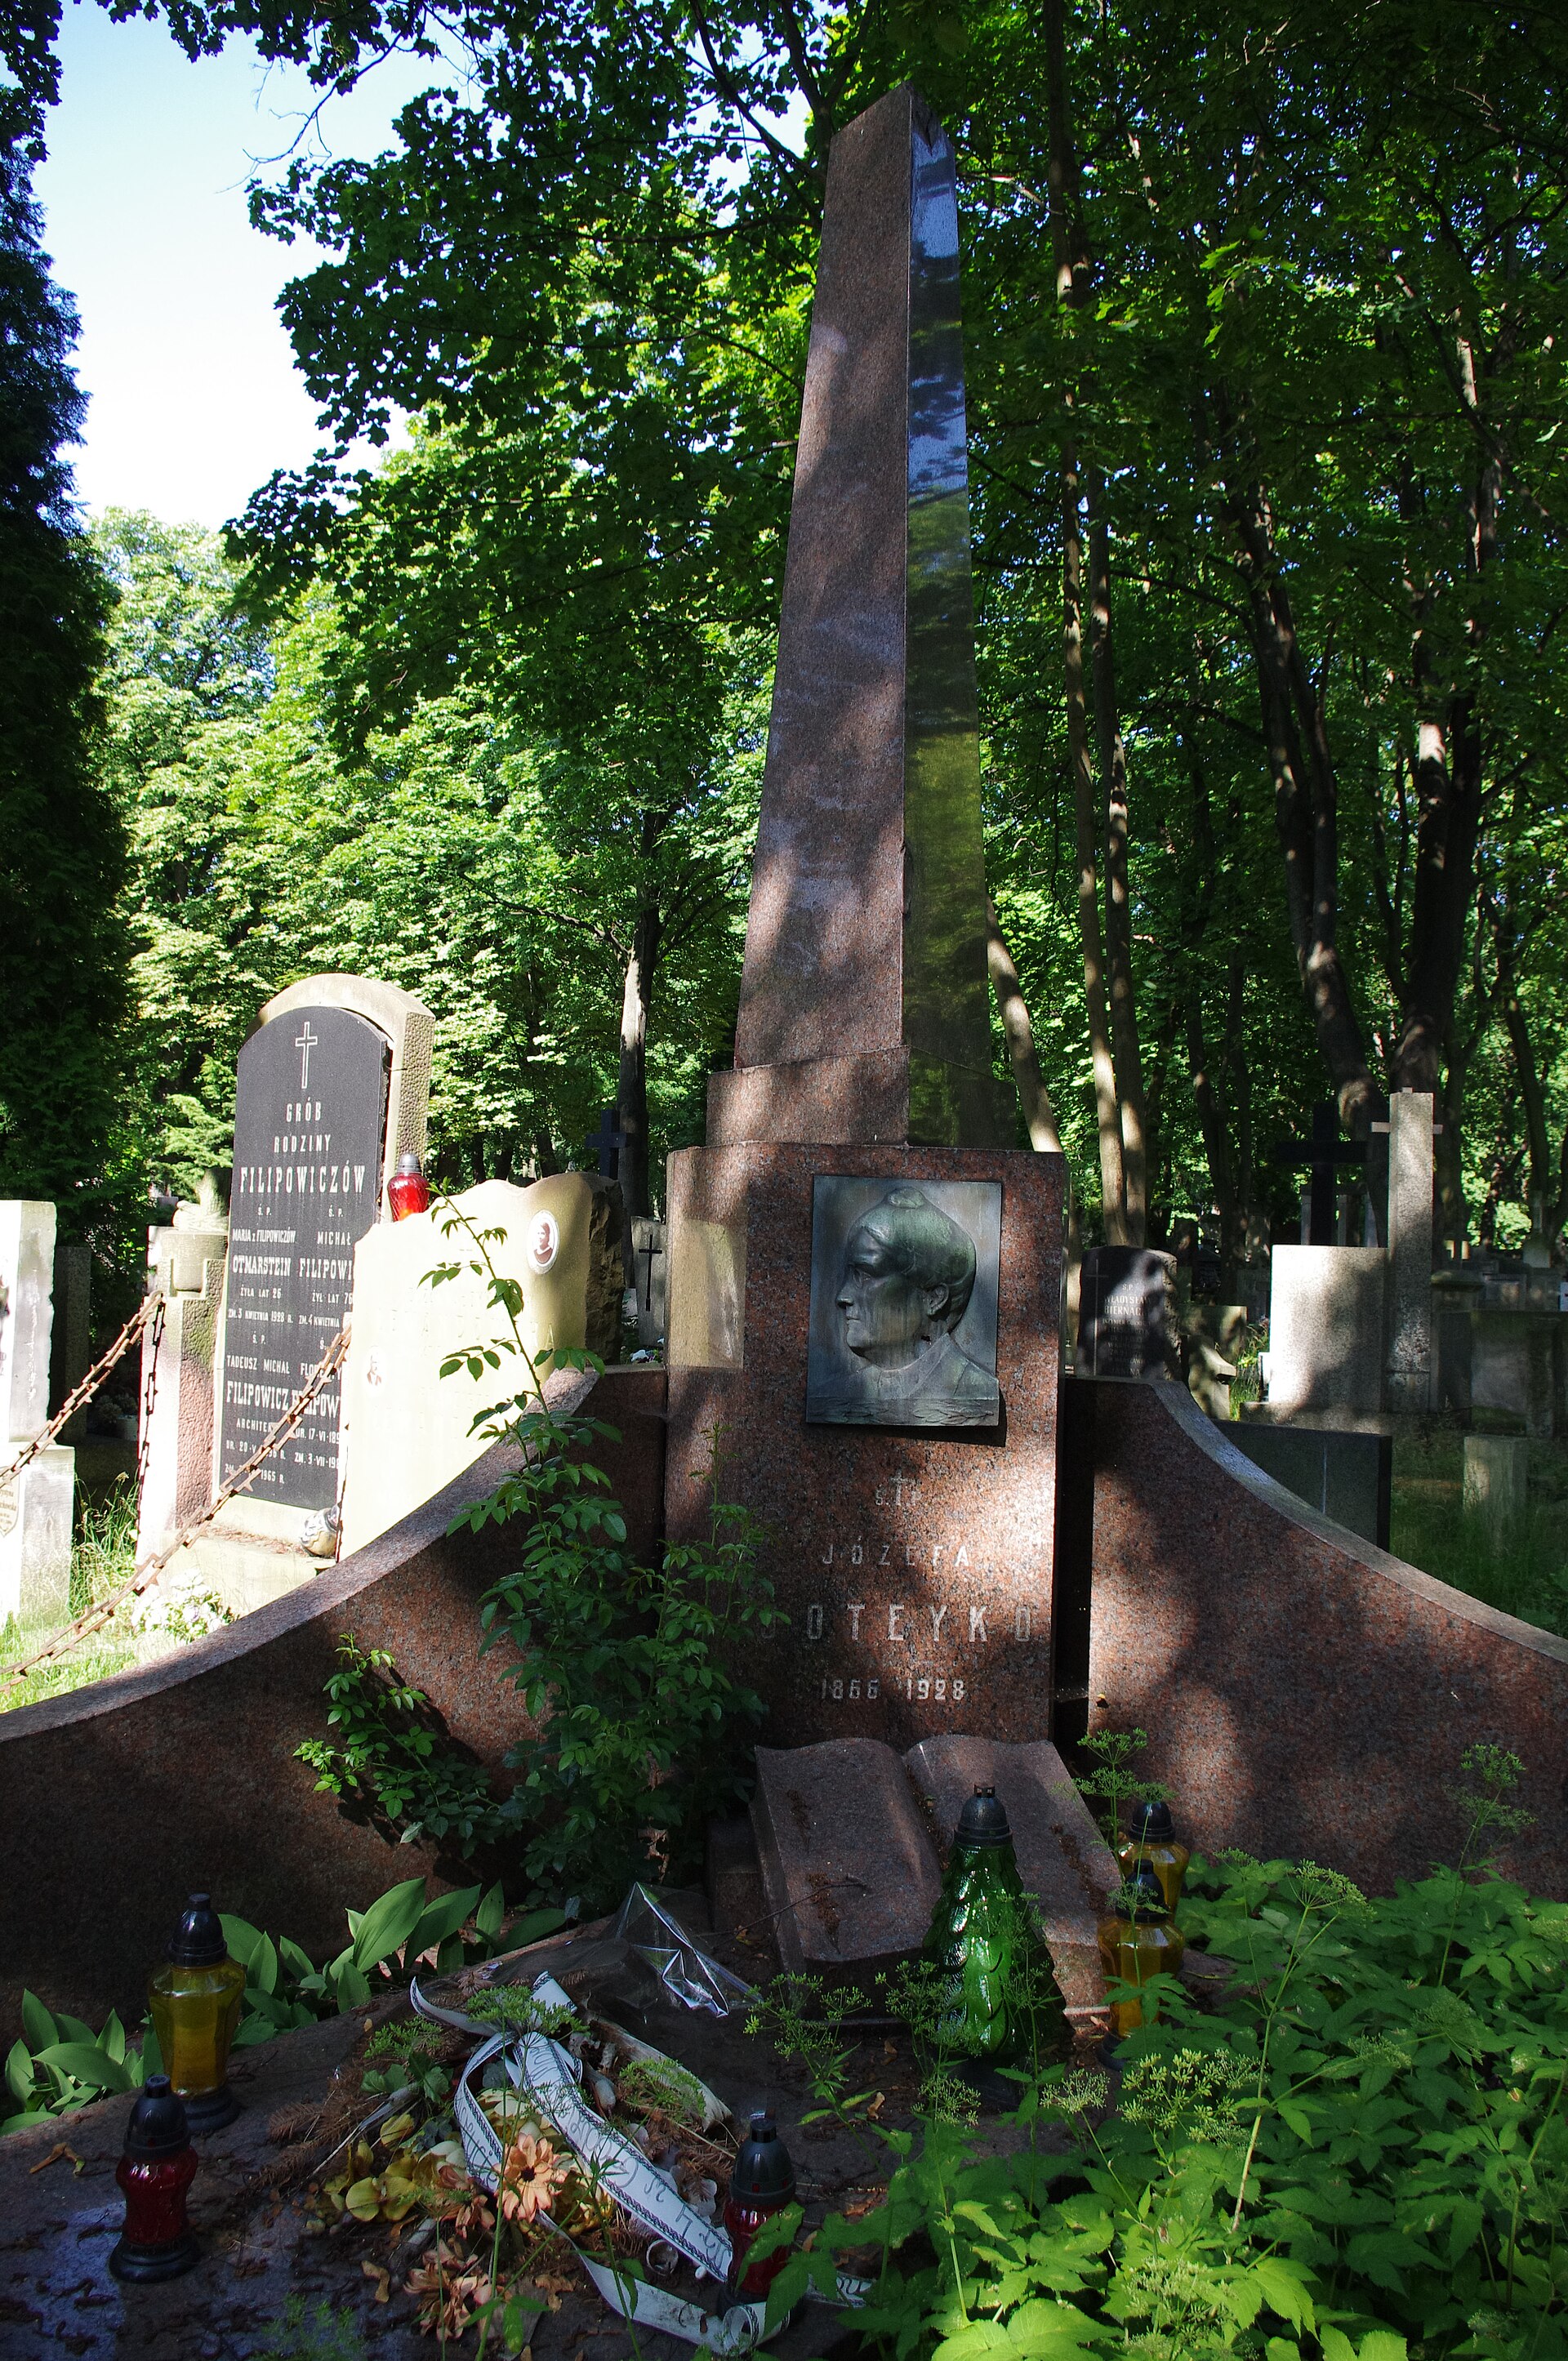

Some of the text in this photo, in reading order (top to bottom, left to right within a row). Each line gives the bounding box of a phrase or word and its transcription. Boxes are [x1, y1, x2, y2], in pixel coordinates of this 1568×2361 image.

[285, 1097, 323, 1122] GRÓB
[274, 1134, 332, 1153] RODZINY
[239, 1160, 366, 1194] FILIPOWICZÓW
[256, 1226, 296, 1244] FILIPOWICZÓW
[317, 1231, 351, 1245] MICHAŁ
[232, 1255, 292, 1276] OTMARSTEIN
[245, 1310, 269, 1321] KWIETNIA
[271, 1311, 285, 1322] 1928
[314, 1316, 340, 1328] KWIETNIA
[226, 1355, 290, 1374] TADEUSZ MICHAŁ
[226, 1381, 289, 1410] FILIPOWICZ
[822, 1535, 970, 1567] JÓZEFA
[905, 1679, 966, 1701] 1928
